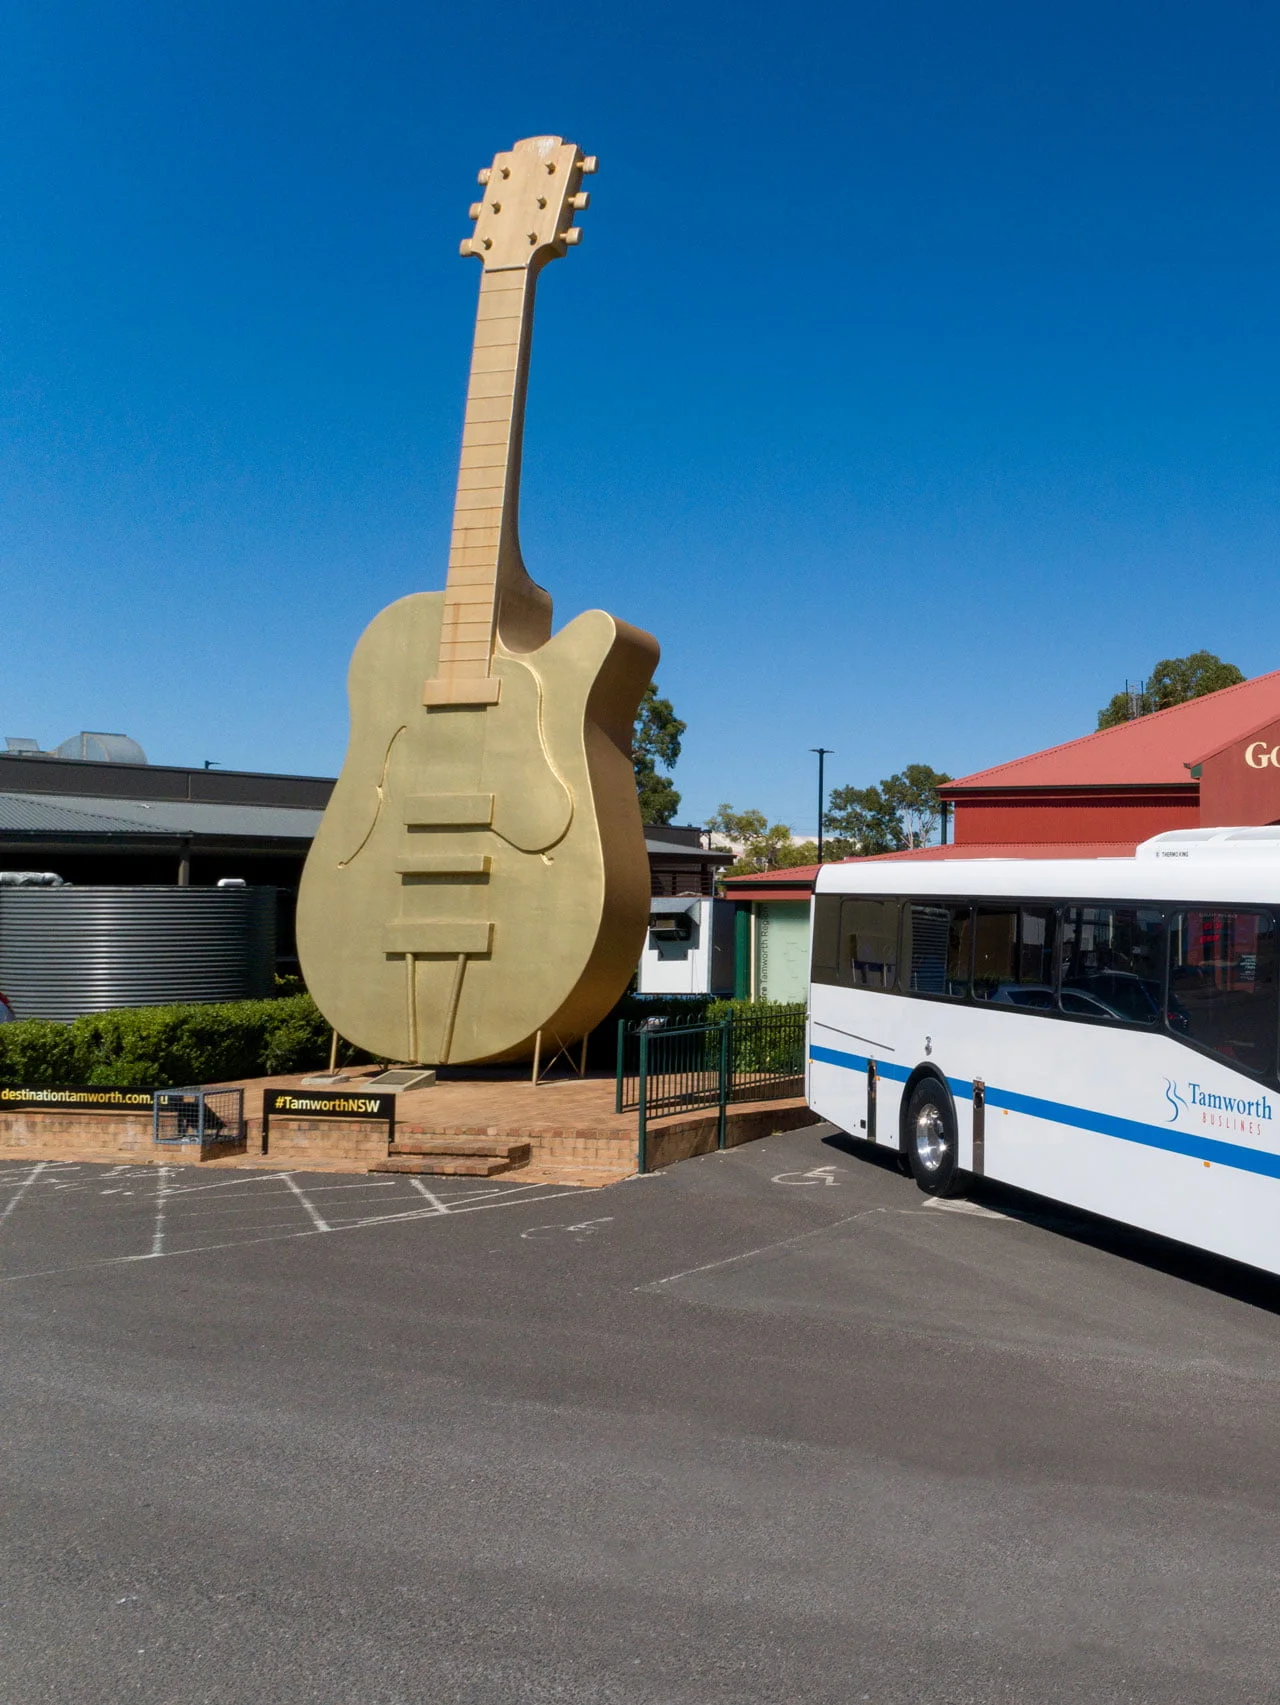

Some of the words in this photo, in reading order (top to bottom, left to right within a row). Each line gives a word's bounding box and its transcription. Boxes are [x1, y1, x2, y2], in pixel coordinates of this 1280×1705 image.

[1, 1088, 169, 1105] destinationtamworth.com.u
[275, 1096, 380, 1113] #TamworthNSW
[1188, 1082, 1272, 1120] Tamworth
[1202, 1112, 1261, 1136] BUSLINES
